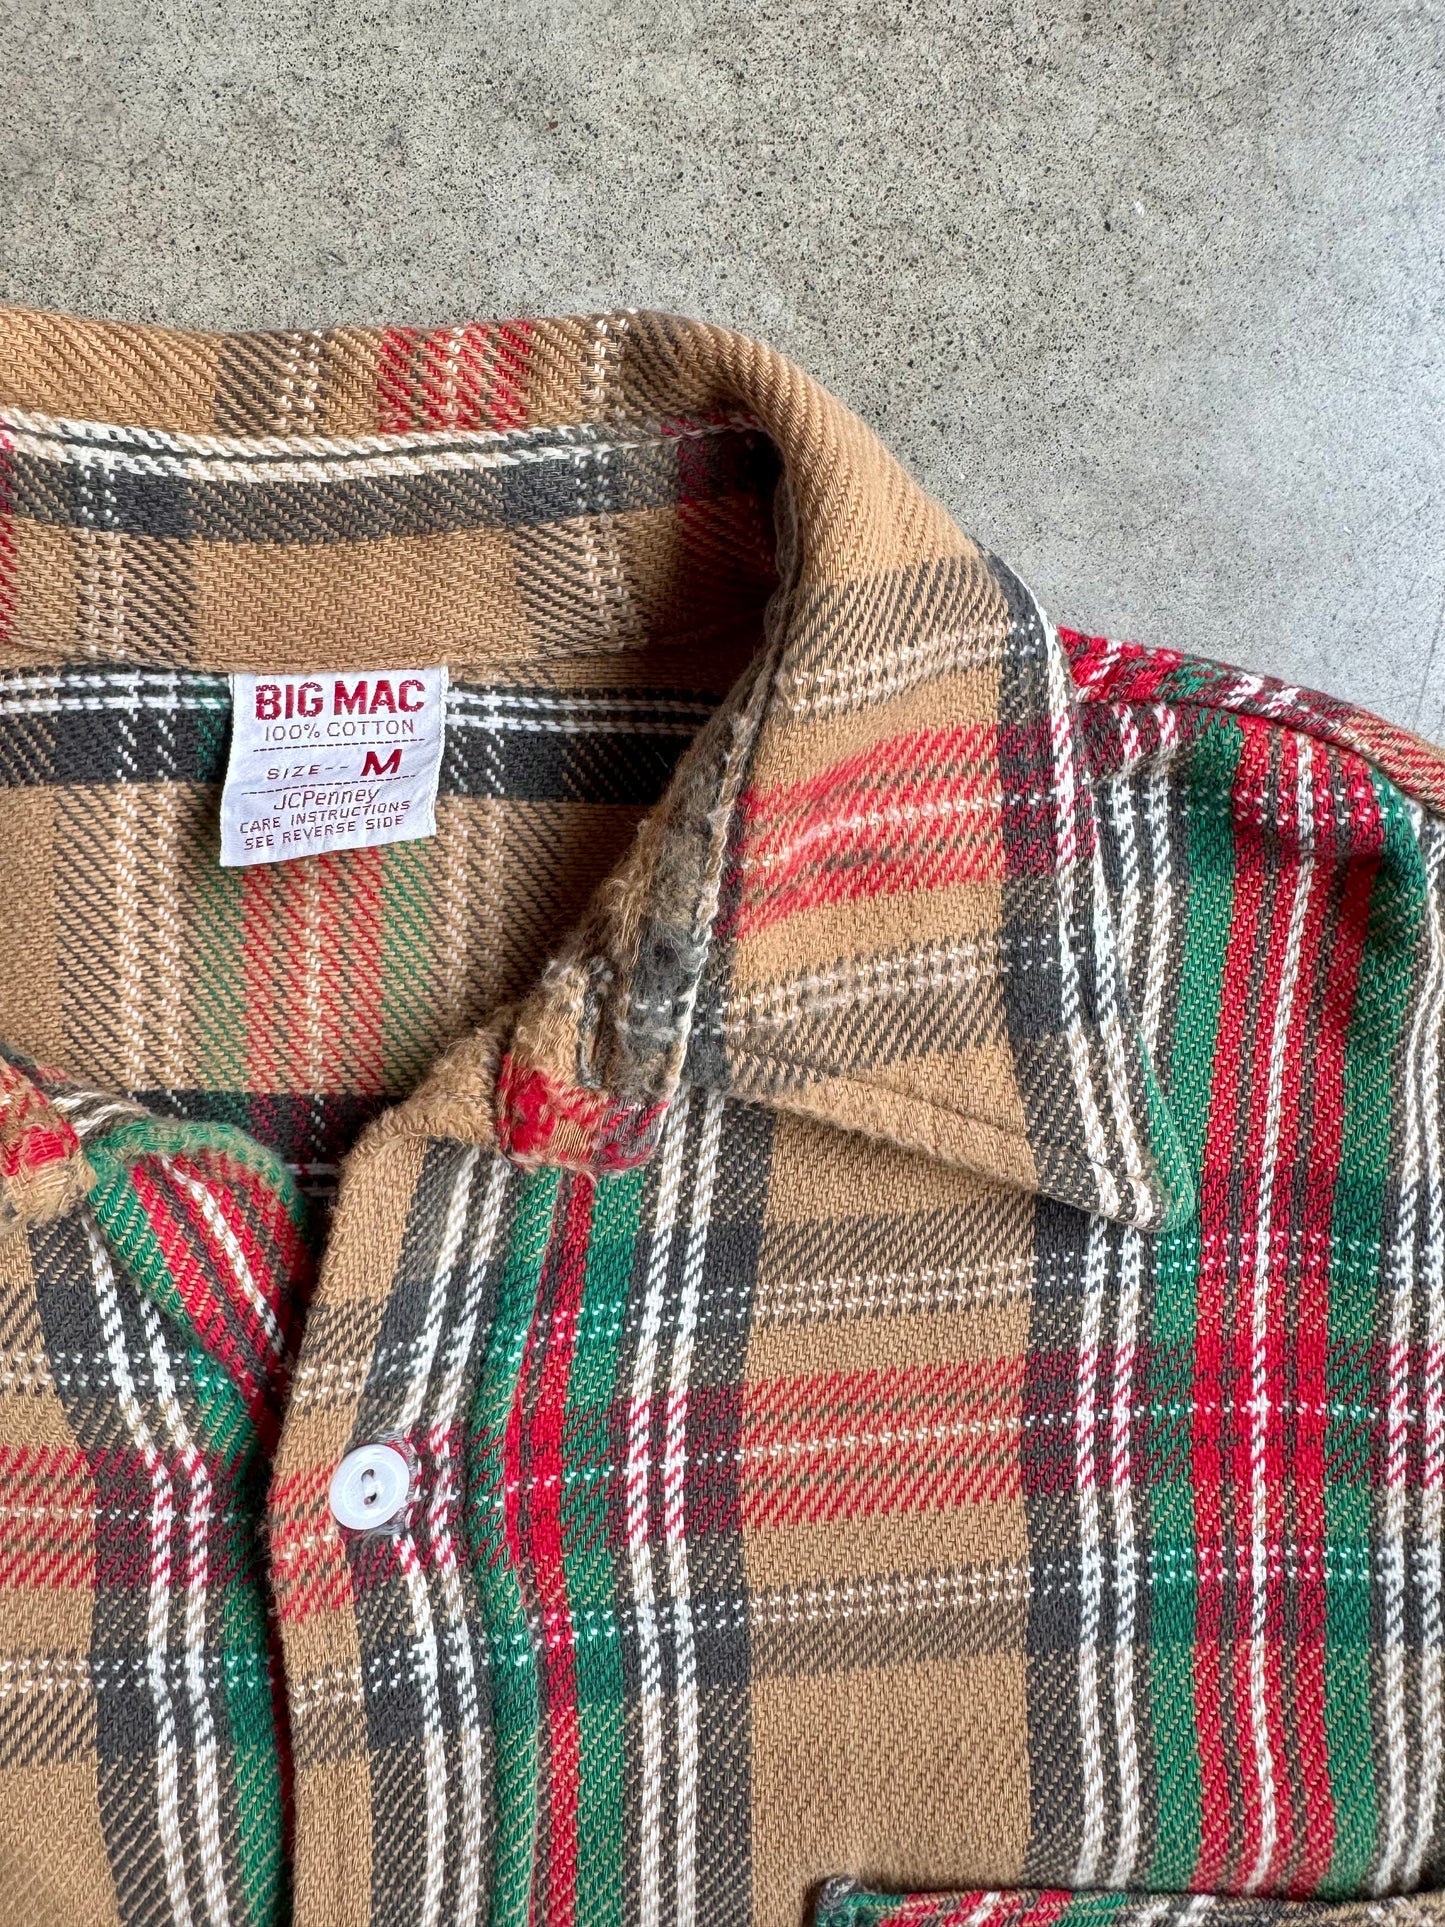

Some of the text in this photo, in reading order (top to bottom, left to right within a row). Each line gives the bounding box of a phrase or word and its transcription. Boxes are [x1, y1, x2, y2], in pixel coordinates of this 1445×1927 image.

[255, 680, 425, 720] BIG MAC
[265, 719, 414, 741] 100% COTTON
[361, 749, 402, 776] M
[274, 788, 380, 810] JCPenney
[240, 800, 410, 834] CARE INSTRUCTIONS
[244, 815, 404, 850] SEE REVERSE SIDE
